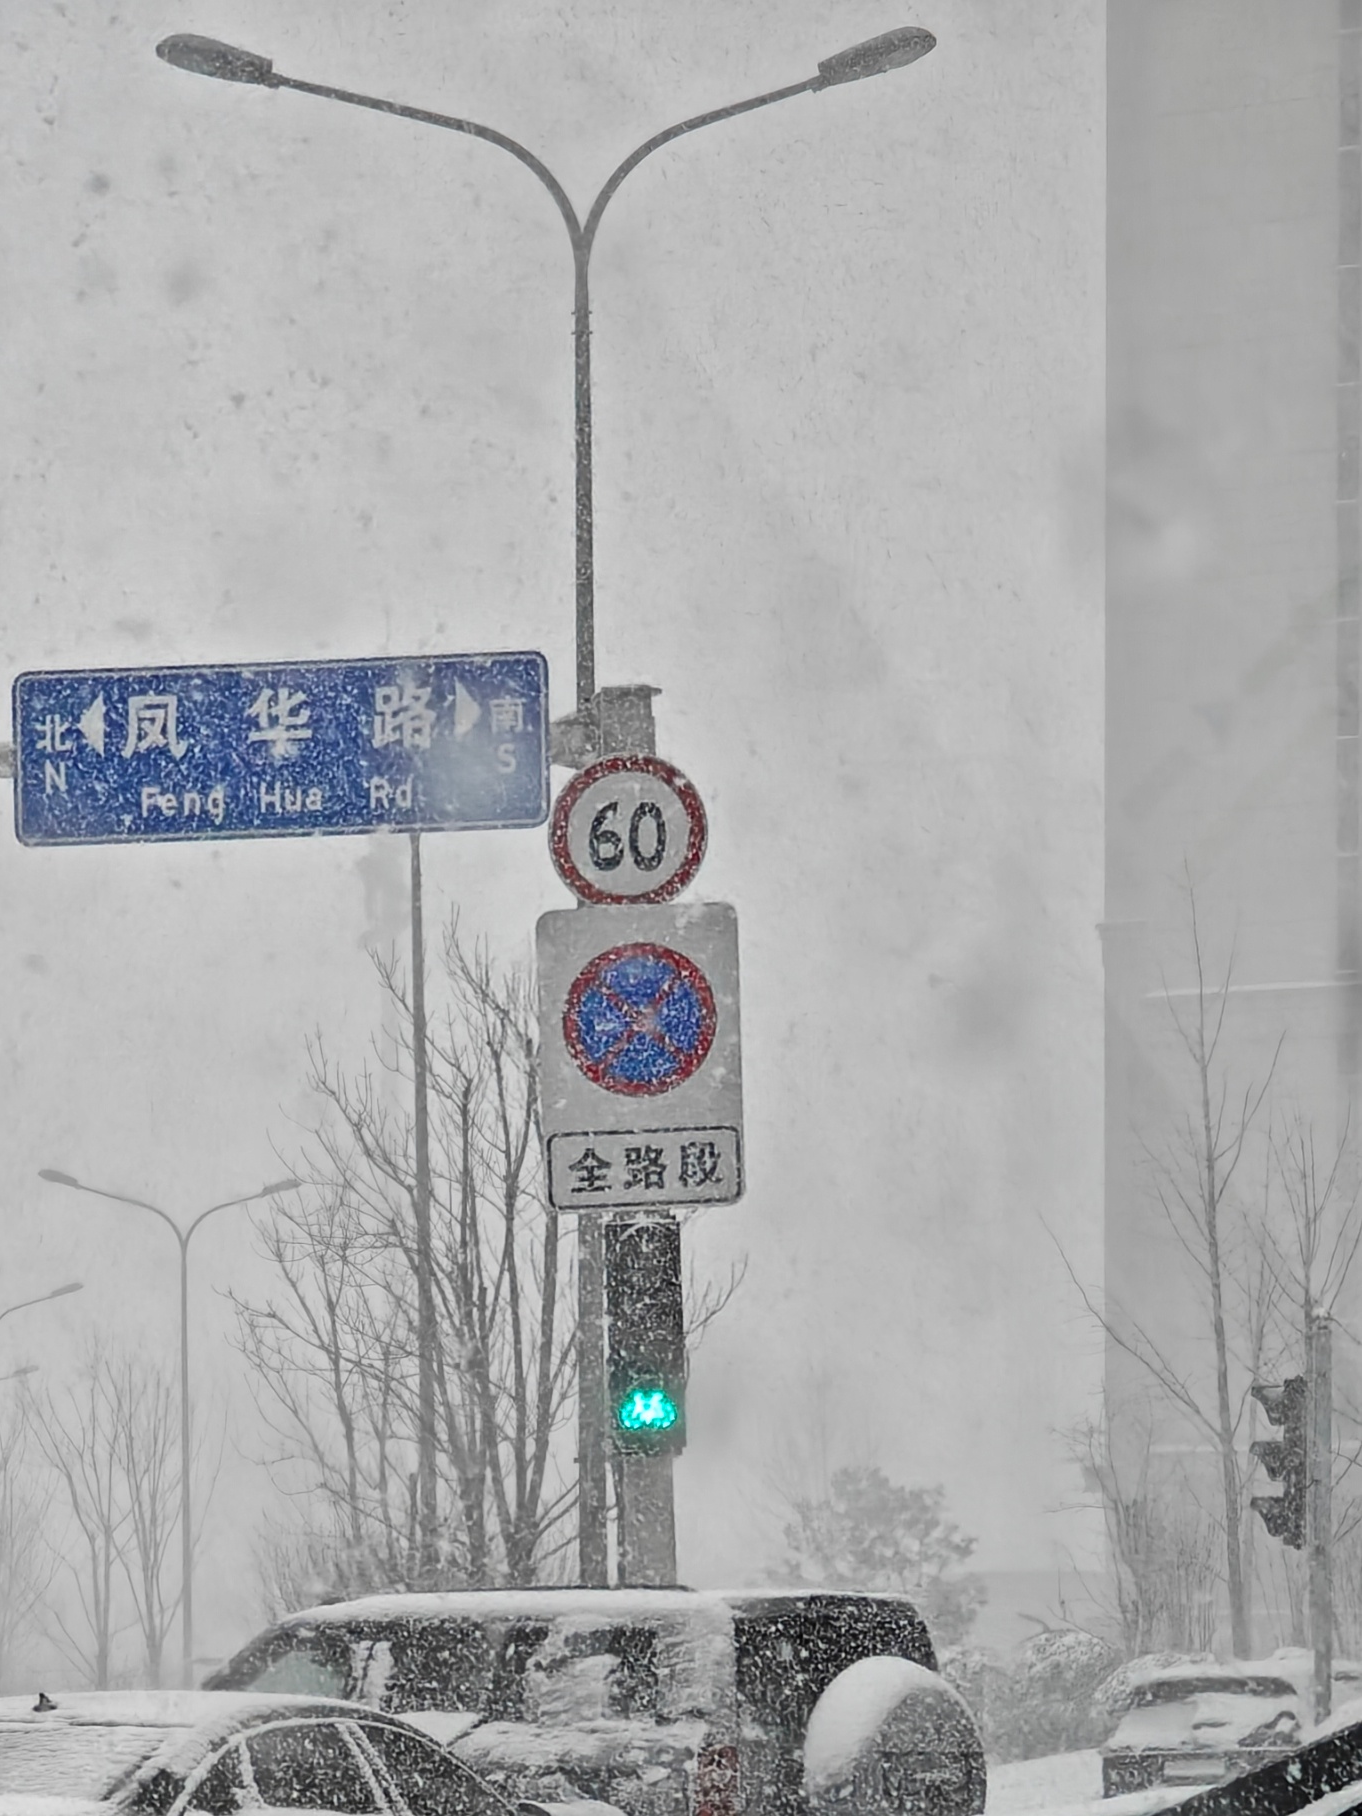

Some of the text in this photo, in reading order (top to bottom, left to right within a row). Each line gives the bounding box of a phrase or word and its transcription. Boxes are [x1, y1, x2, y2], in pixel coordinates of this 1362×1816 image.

[37, 713, 74, 754] 北
[121, 684, 437, 762] 凤华路
[488, 697, 526, 733] 南
[44, 759, 68, 796] N
[495, 742, 517, 775] S
[140, 775, 414, 825] Feng Hua Rd
[588, 801, 668, 873] 60
[568, 1142, 724, 1193] 全路段
